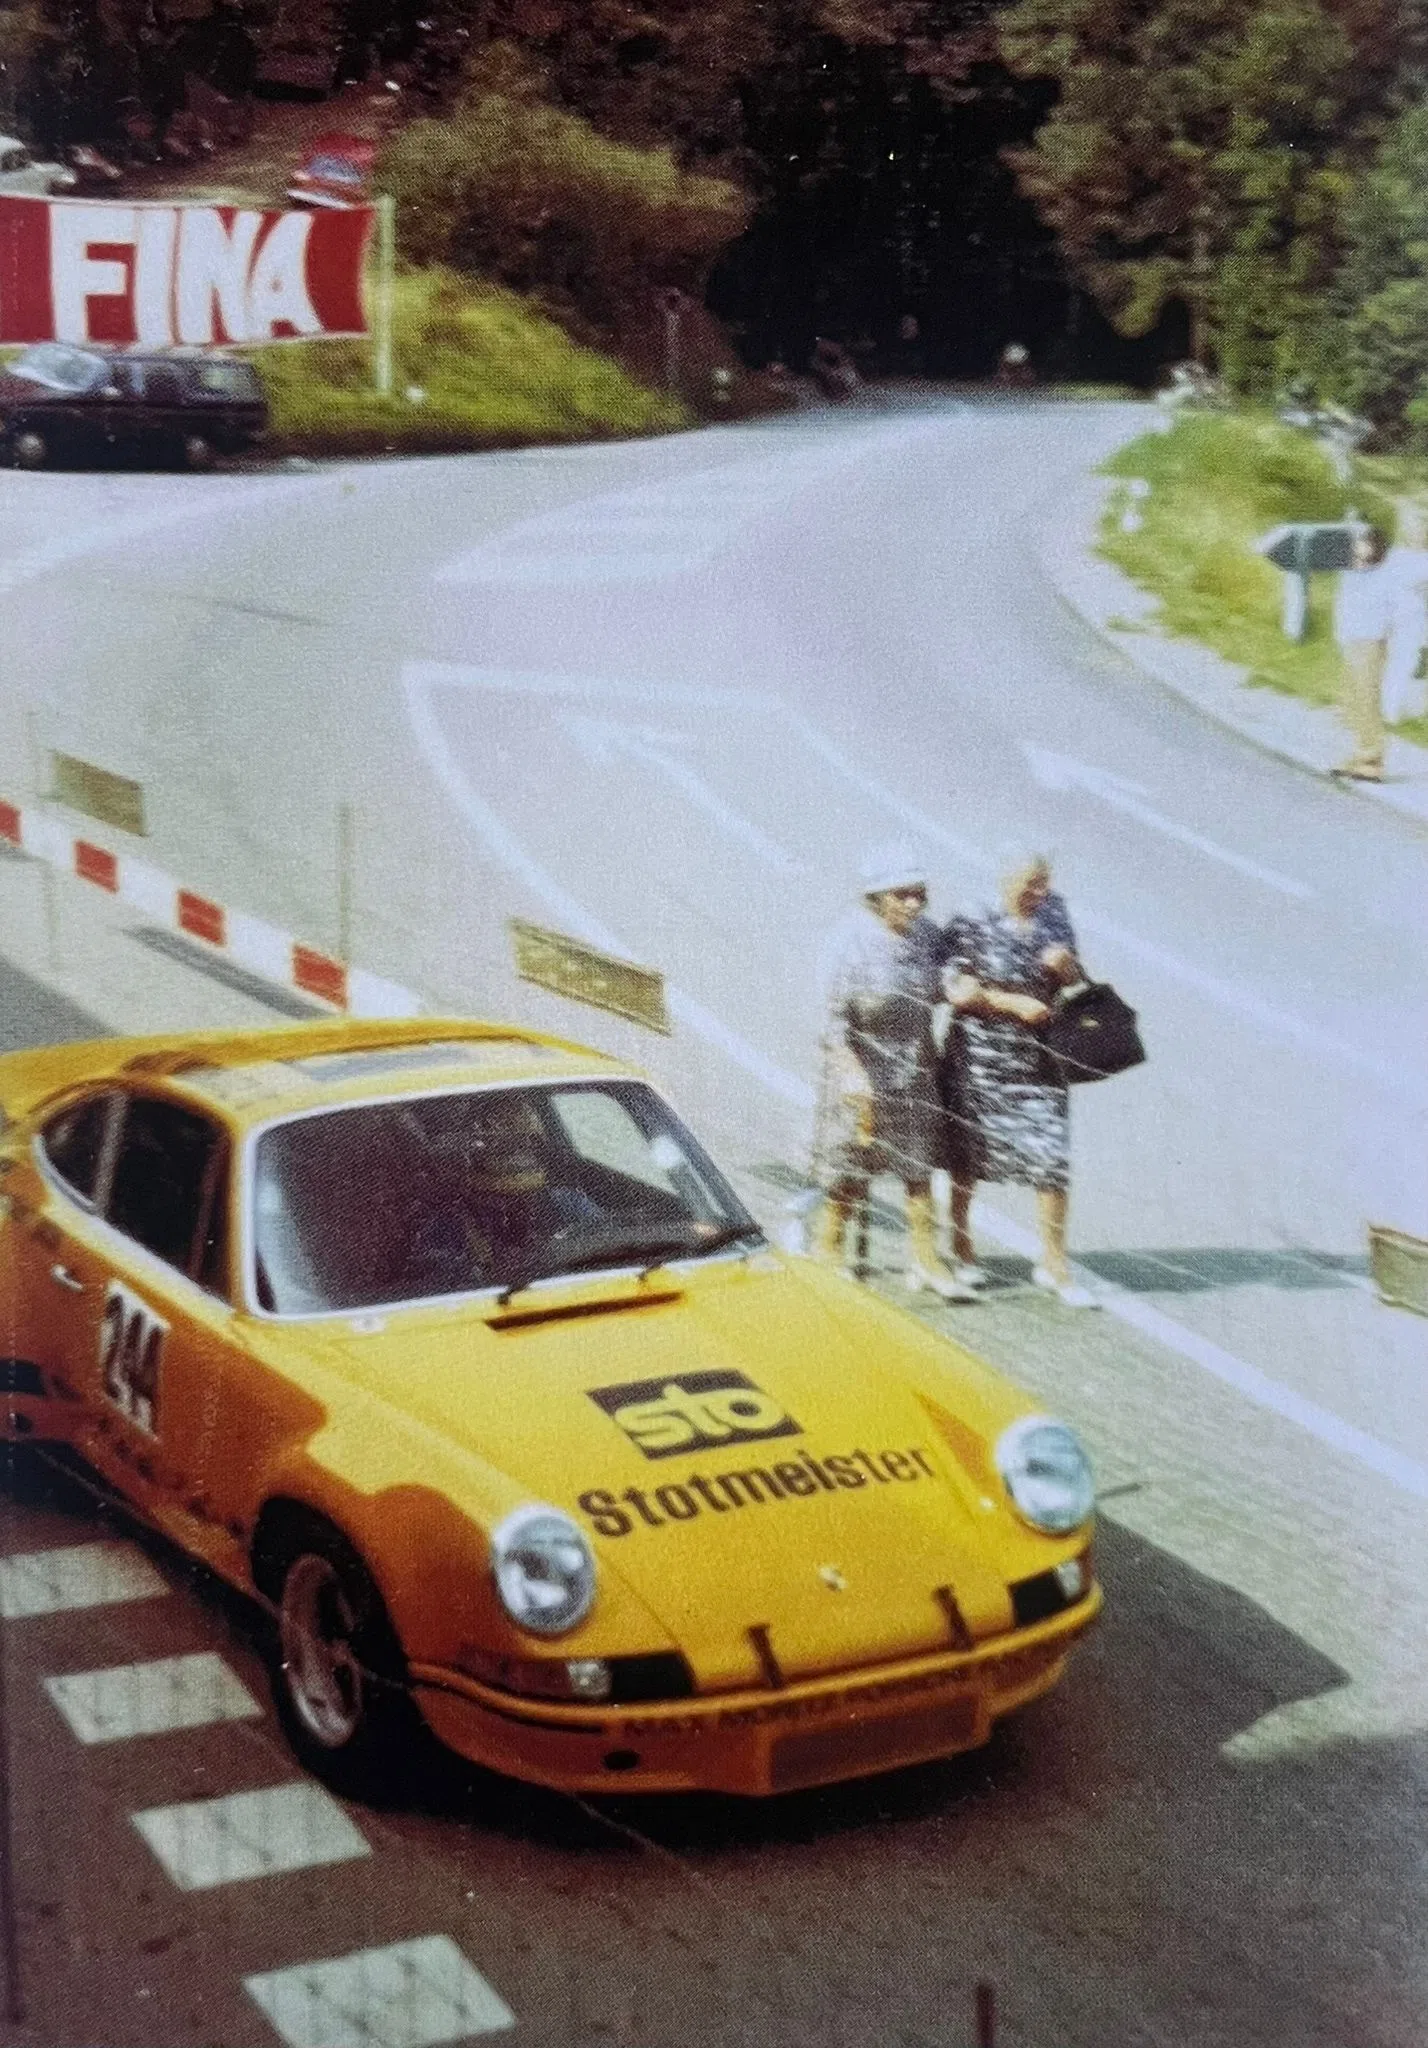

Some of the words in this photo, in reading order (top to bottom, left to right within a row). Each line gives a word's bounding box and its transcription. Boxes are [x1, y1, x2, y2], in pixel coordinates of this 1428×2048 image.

[50, 203, 326, 345] FINA
[614, 1384, 785, 1449] sto
[577, 1449, 935, 1538] Stotmeister
